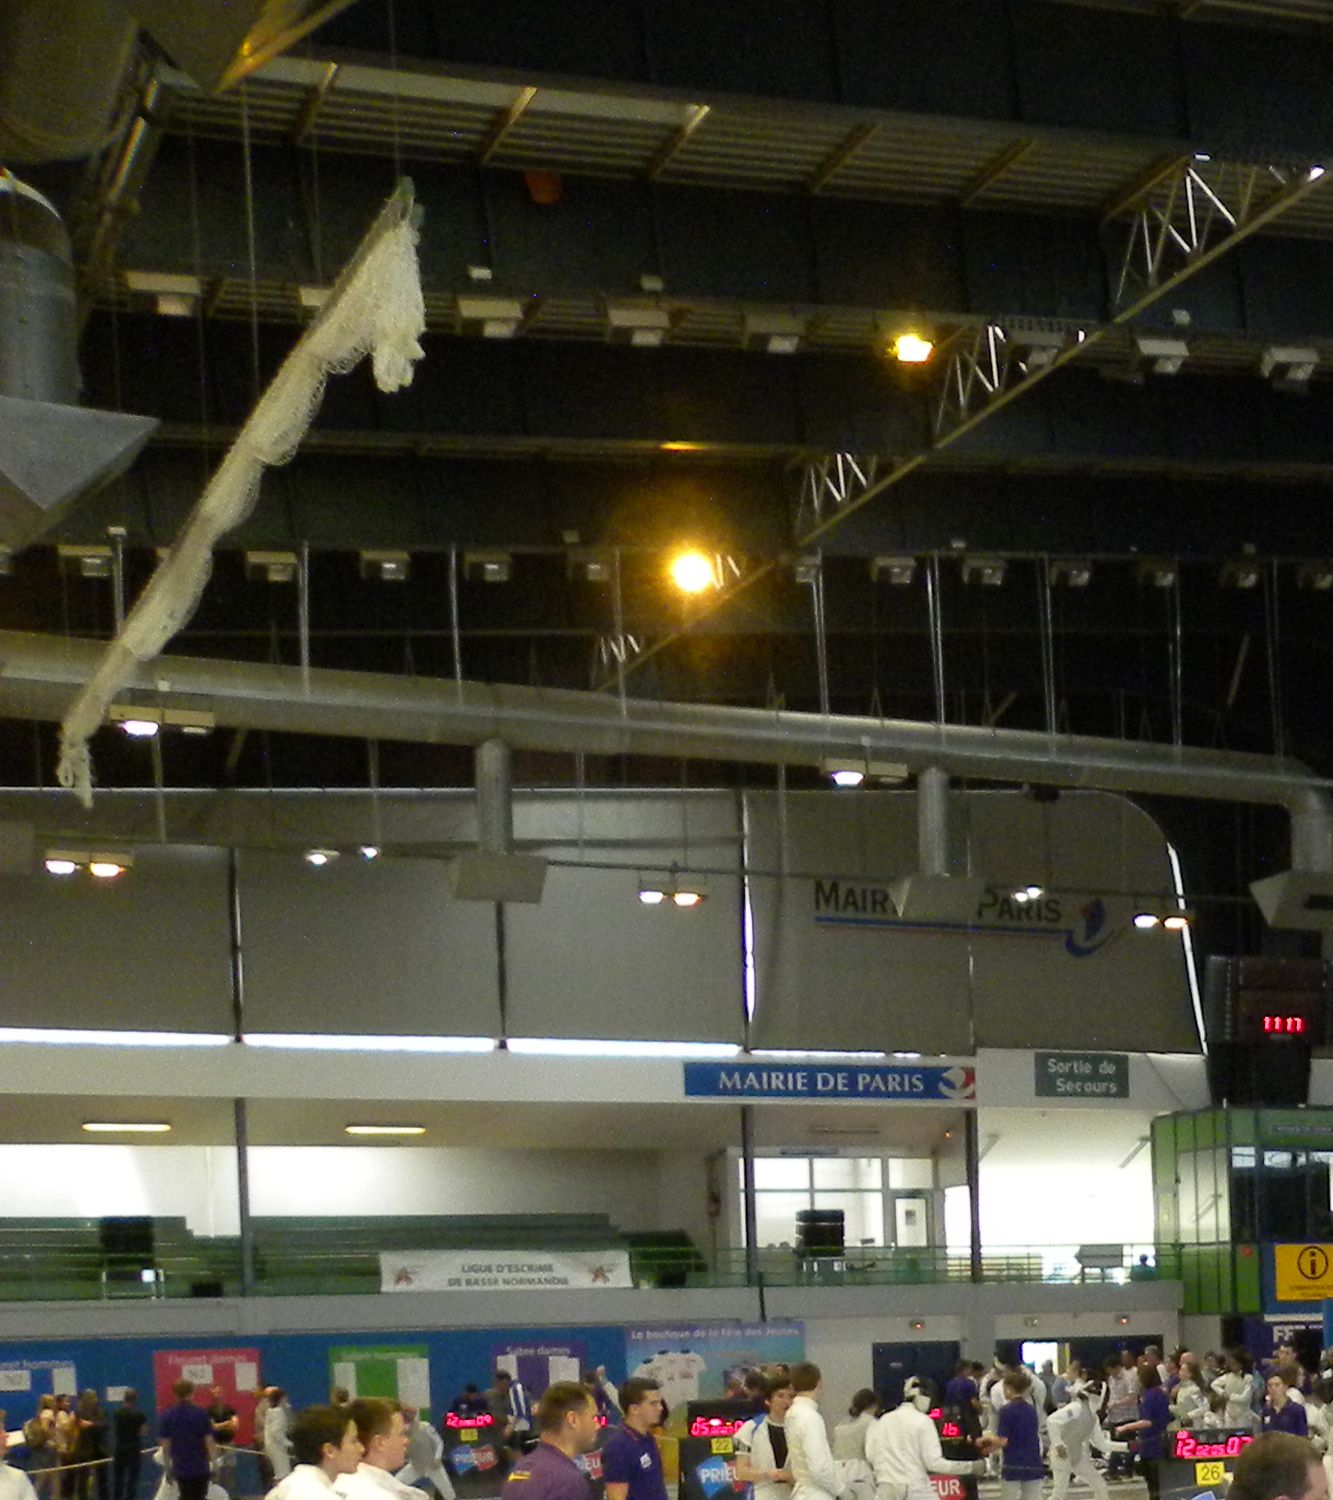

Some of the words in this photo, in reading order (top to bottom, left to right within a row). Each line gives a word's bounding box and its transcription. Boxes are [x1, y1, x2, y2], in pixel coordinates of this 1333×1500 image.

[814, 879, 903, 915] MAIR
[1047, 1058, 1092, 1074] Sortie
[1099, 1062, 1117, 1075] de
[719, 1070, 808, 1091] MAIRIE
[816, 1072, 849, 1091] DE
[857, 1073, 924, 1093] PARIS
[1055, 1078, 1118, 1095] Secours
[461, 1263, 494, 1274] LIGUE
[496, 1263, 554, 1274] D'ESCRIME
[447, 1276, 463, 1287] DE
[465, 1276, 499, 1287] BASSE
[502, 1276, 570, 1287] NORMANDIE
[1200, 1464, 1221, 1481] 26
